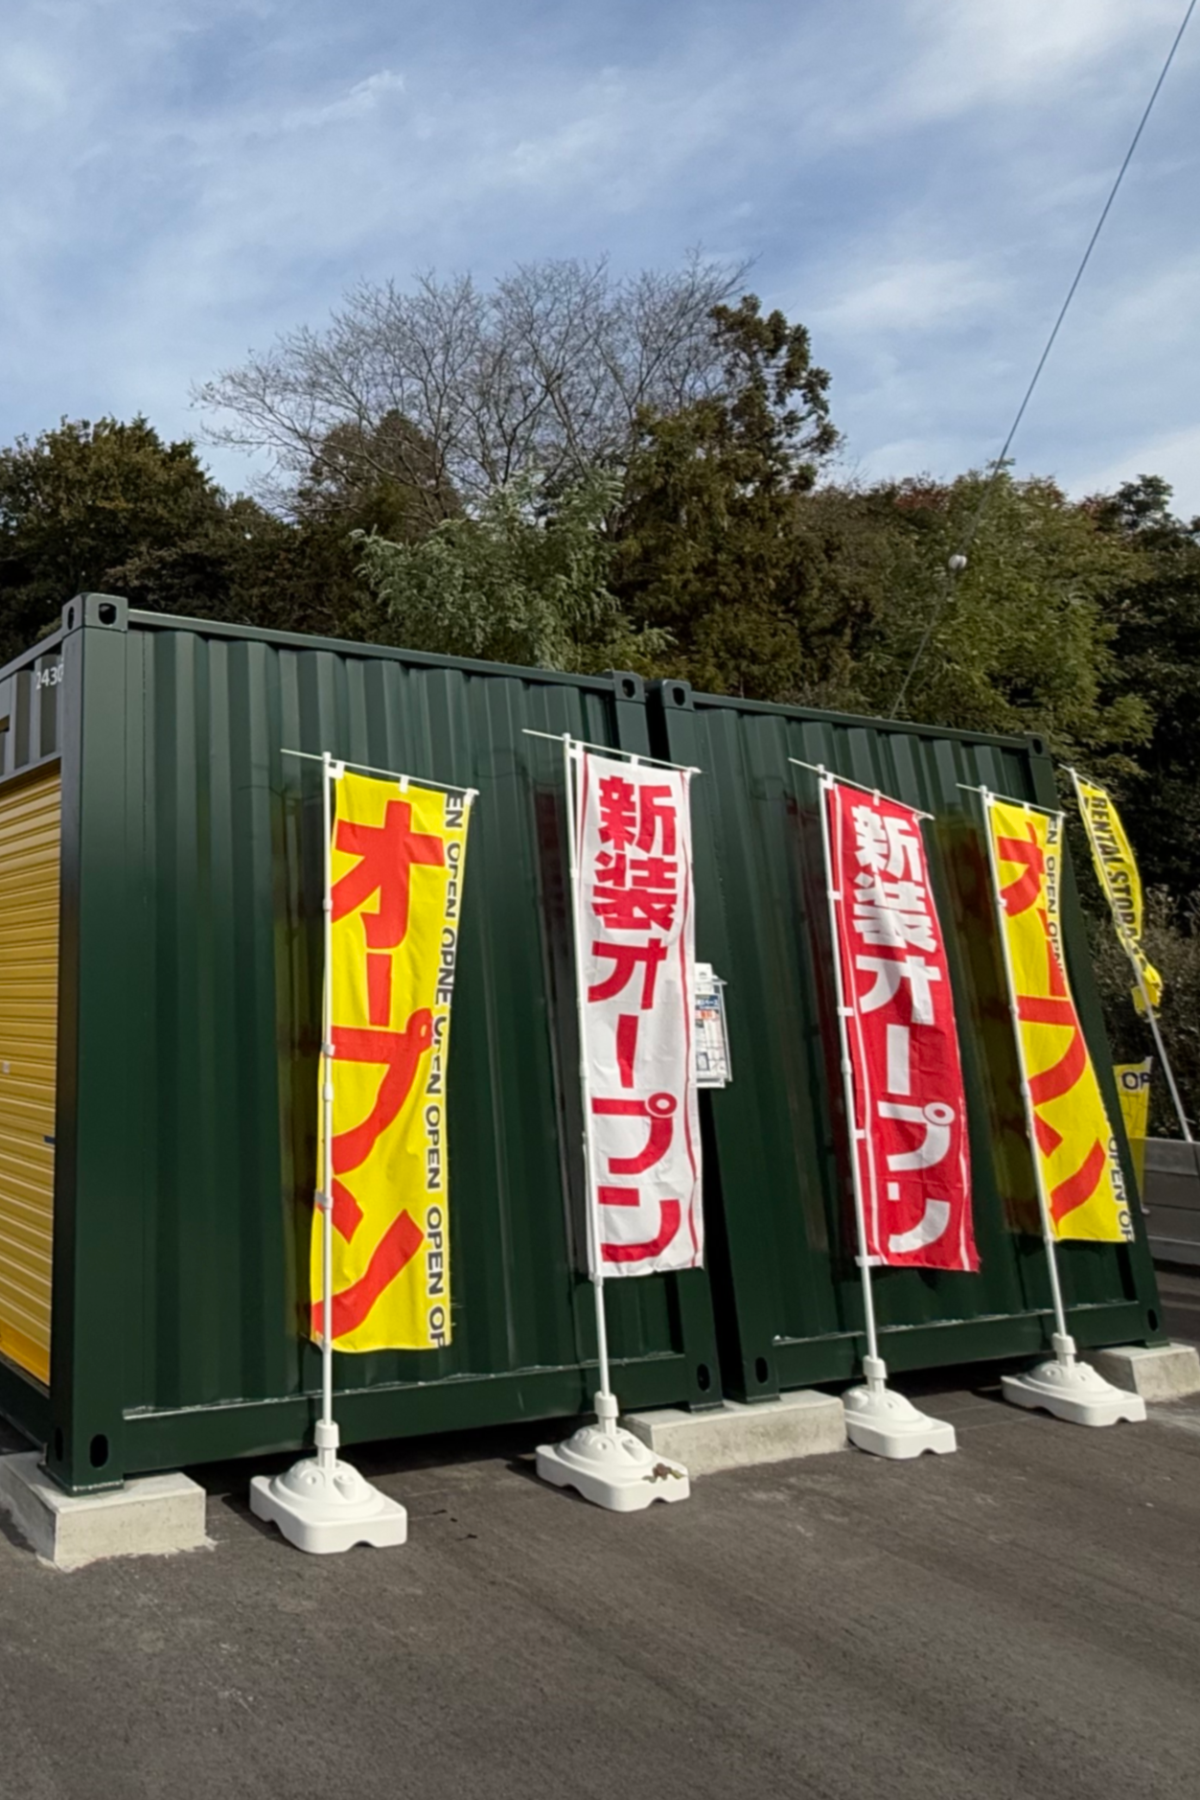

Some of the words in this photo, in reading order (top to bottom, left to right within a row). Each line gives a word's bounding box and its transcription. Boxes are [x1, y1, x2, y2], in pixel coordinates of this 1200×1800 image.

[1091, 796, 1125, 863] RENTAL
[435, 928, 456, 1005] OPNE
[587, 775, 681, 1262] 新装オープン
[853, 804, 954, 1254] 新装オープン
[311, 800, 446, 1339] オープン
[425, 1105, 441, 1190] OPEN
[427, 1206, 444, 1295] OPEN
